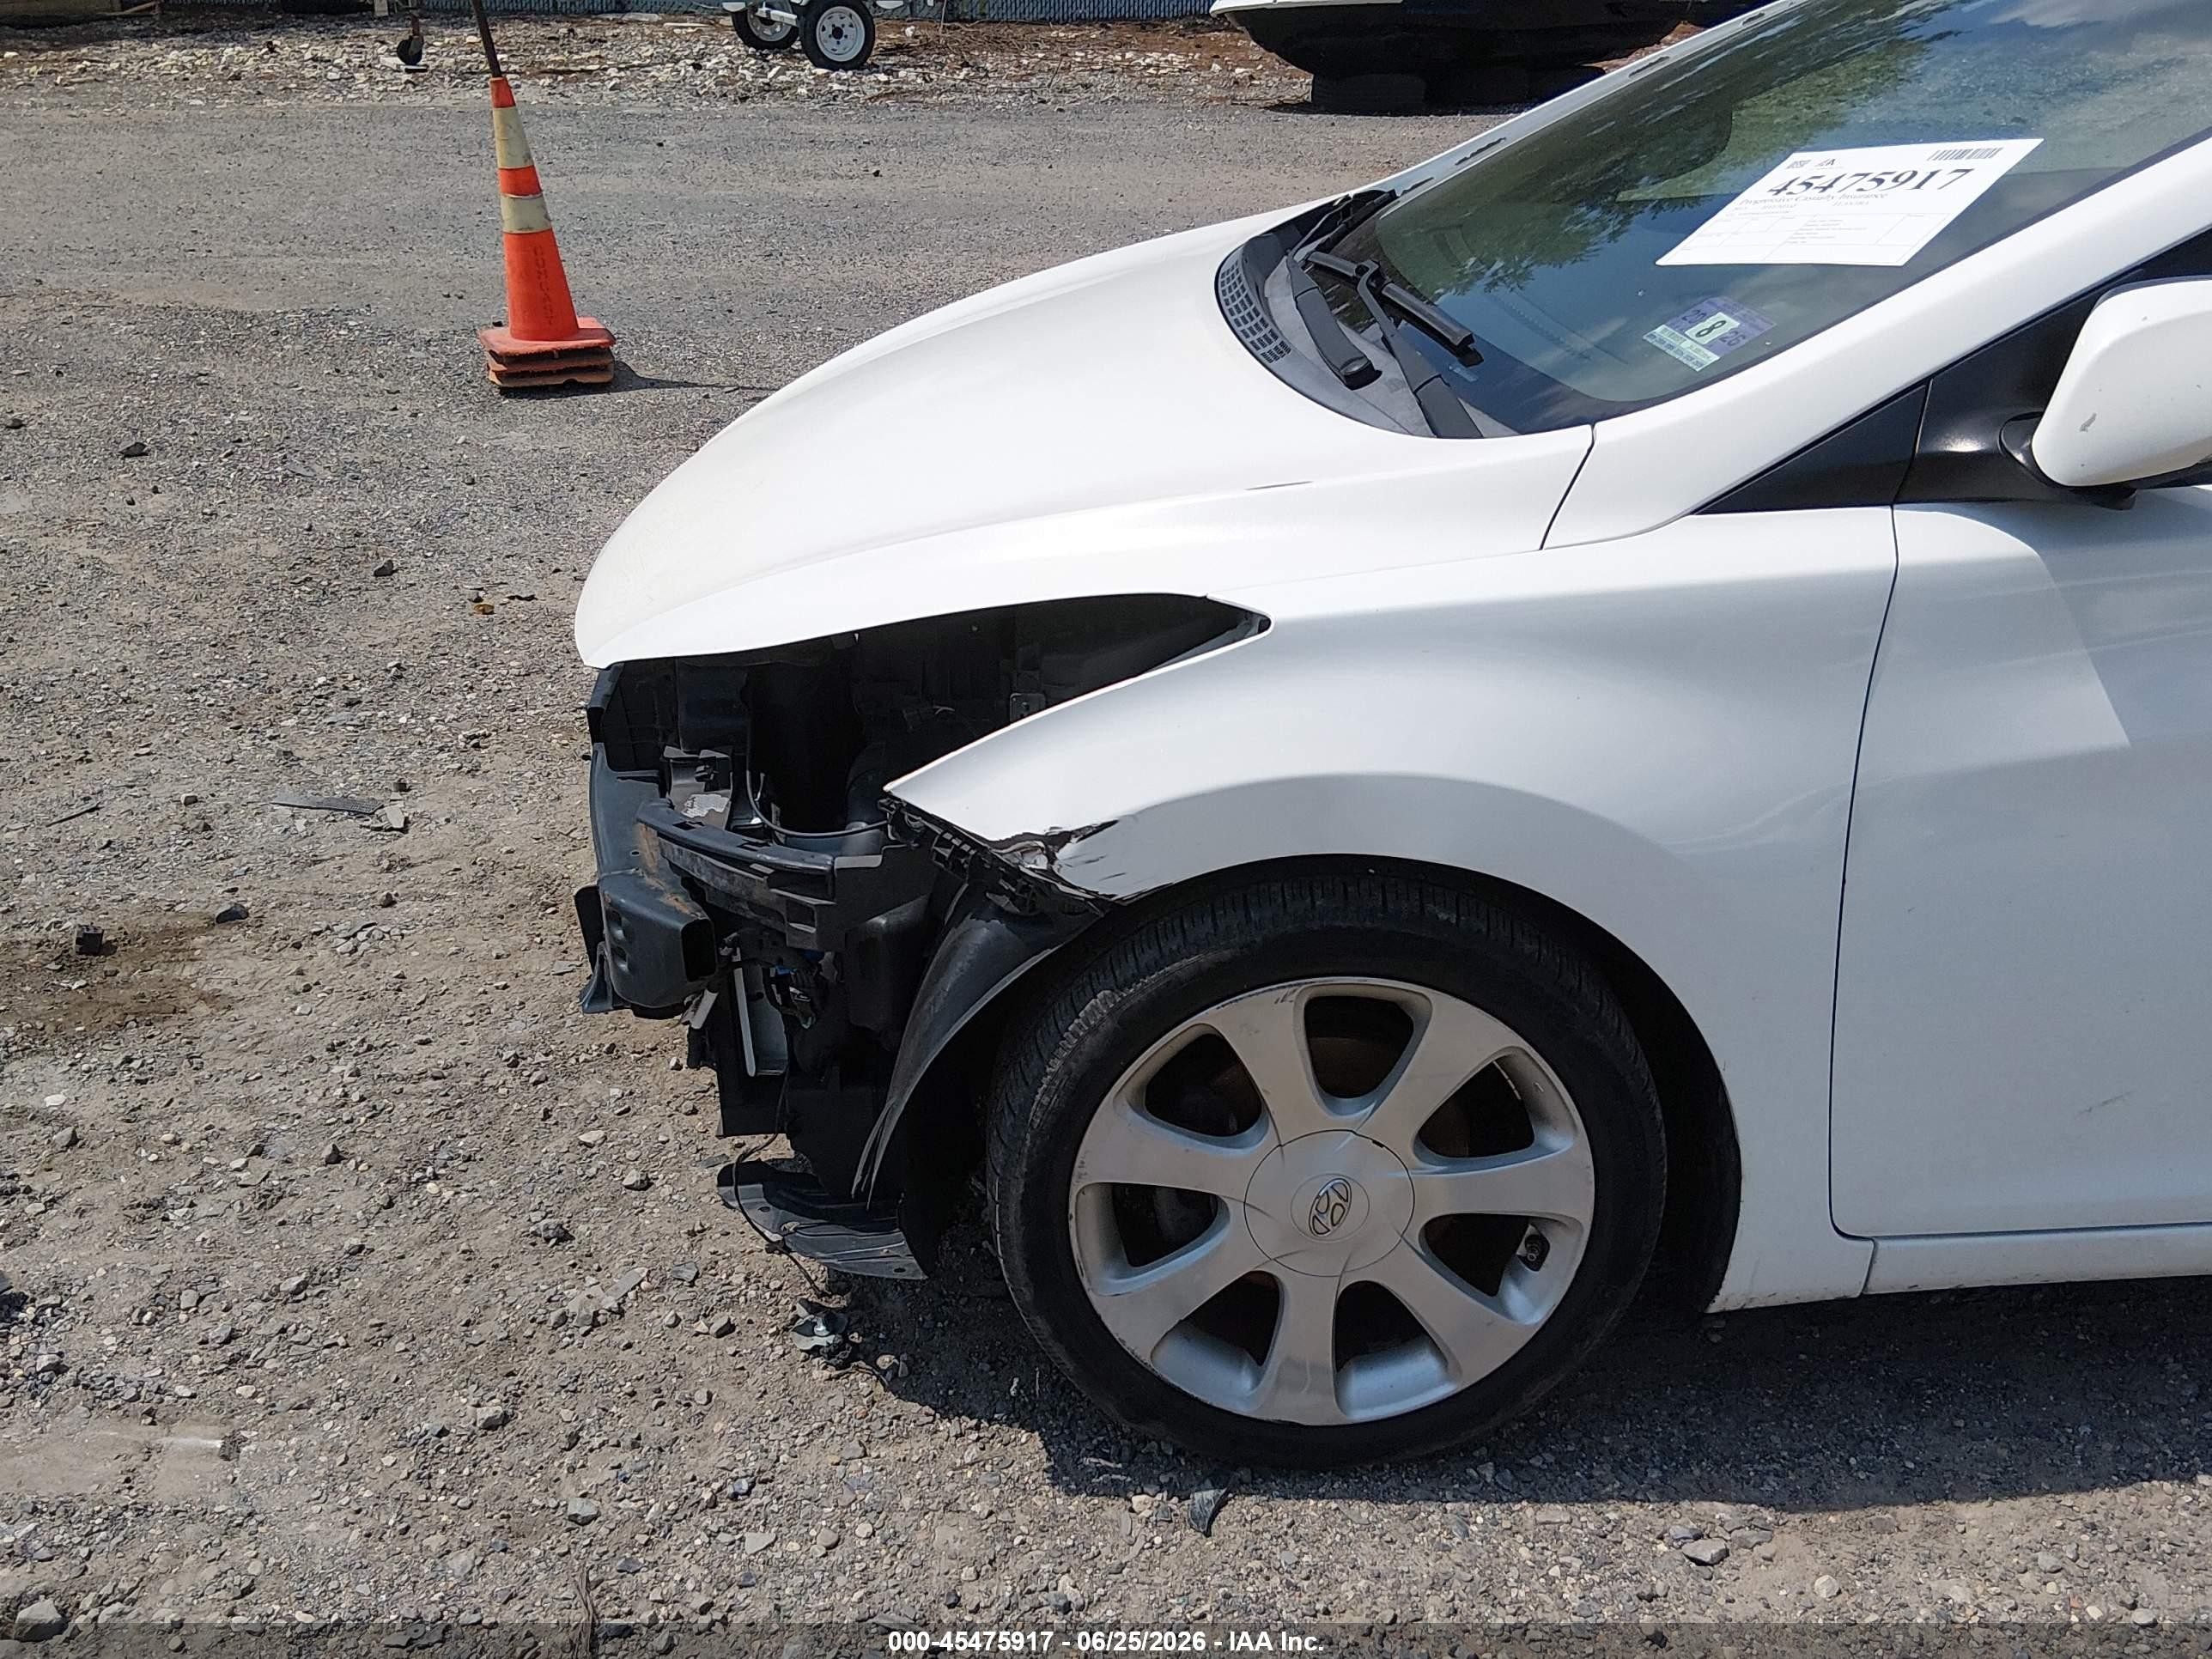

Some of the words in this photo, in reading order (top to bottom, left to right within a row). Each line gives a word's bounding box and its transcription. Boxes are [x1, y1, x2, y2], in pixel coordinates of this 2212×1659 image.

[1766, 167, 1975, 197] 45475917
[1695, 319, 1727, 338] 8
[1718, 329, 1746, 347] 26
